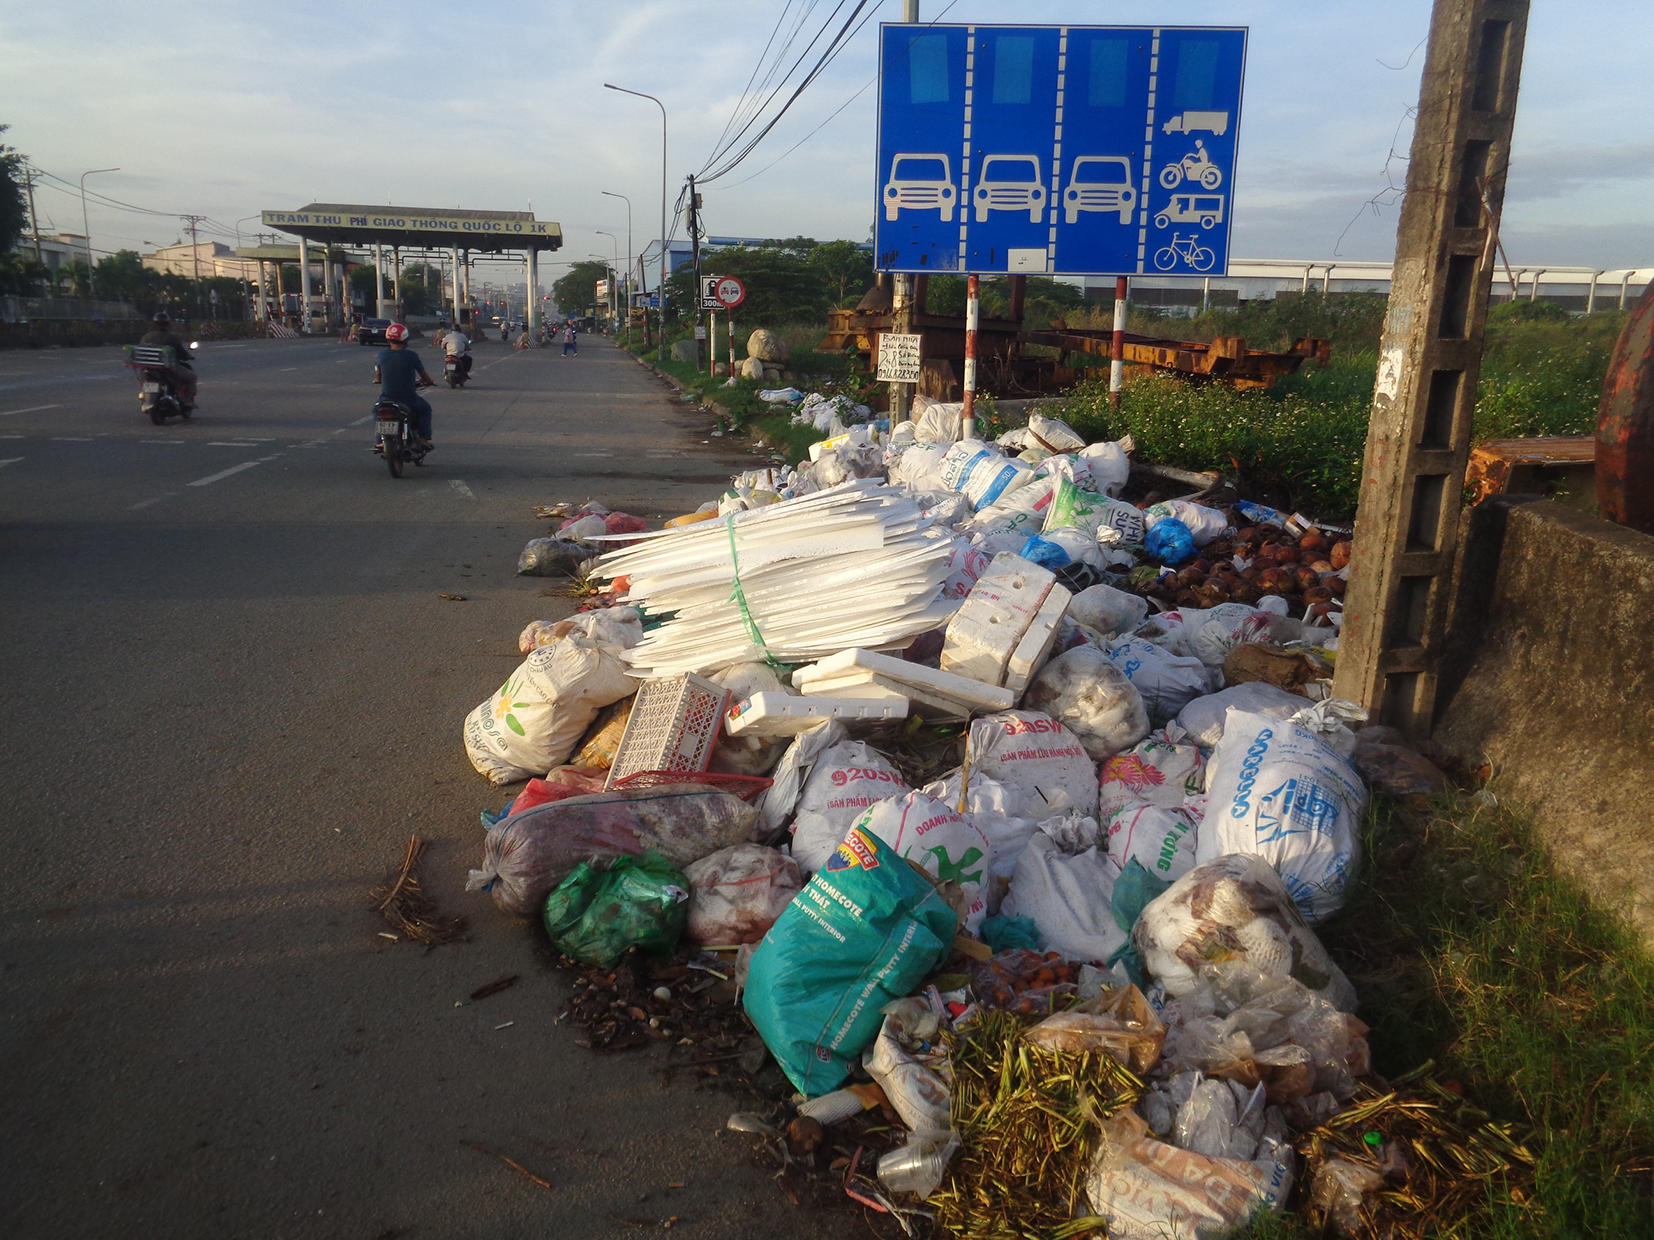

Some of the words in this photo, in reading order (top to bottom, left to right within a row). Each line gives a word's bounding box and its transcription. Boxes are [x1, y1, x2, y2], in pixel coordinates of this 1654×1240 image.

[267, 214, 309, 224] TRẠM
[313, 215, 342, 224] THU
[350, 216, 367, 226] PHÍ
[372, 218, 406, 228] GIAO
[410, 218, 458, 230] THÔNG
[462, 220, 501, 232] QUỐC
[506, 222, 522, 234] LỘ
[530, 224, 546, 232] 1K
[1002, 472, 1011, 480] 50
[1126, 516, 1141, 542] WHI
[1299, 772, 1320, 785] 1941
[916, 814, 948, 836] DOANH
[844, 832, 874, 864] ECOTE
[816, 877, 863, 917] HOMECOTE
[802, 904, 819, 922] PUTTY
[818, 918, 846, 944] INTERIOR
[830, 998, 865, 1050] HOMECOTE
[861, 978, 880, 998] WALL
[878, 954, 900, 979] PUTTY
[1101, 1172, 1153, 1214] VICE
